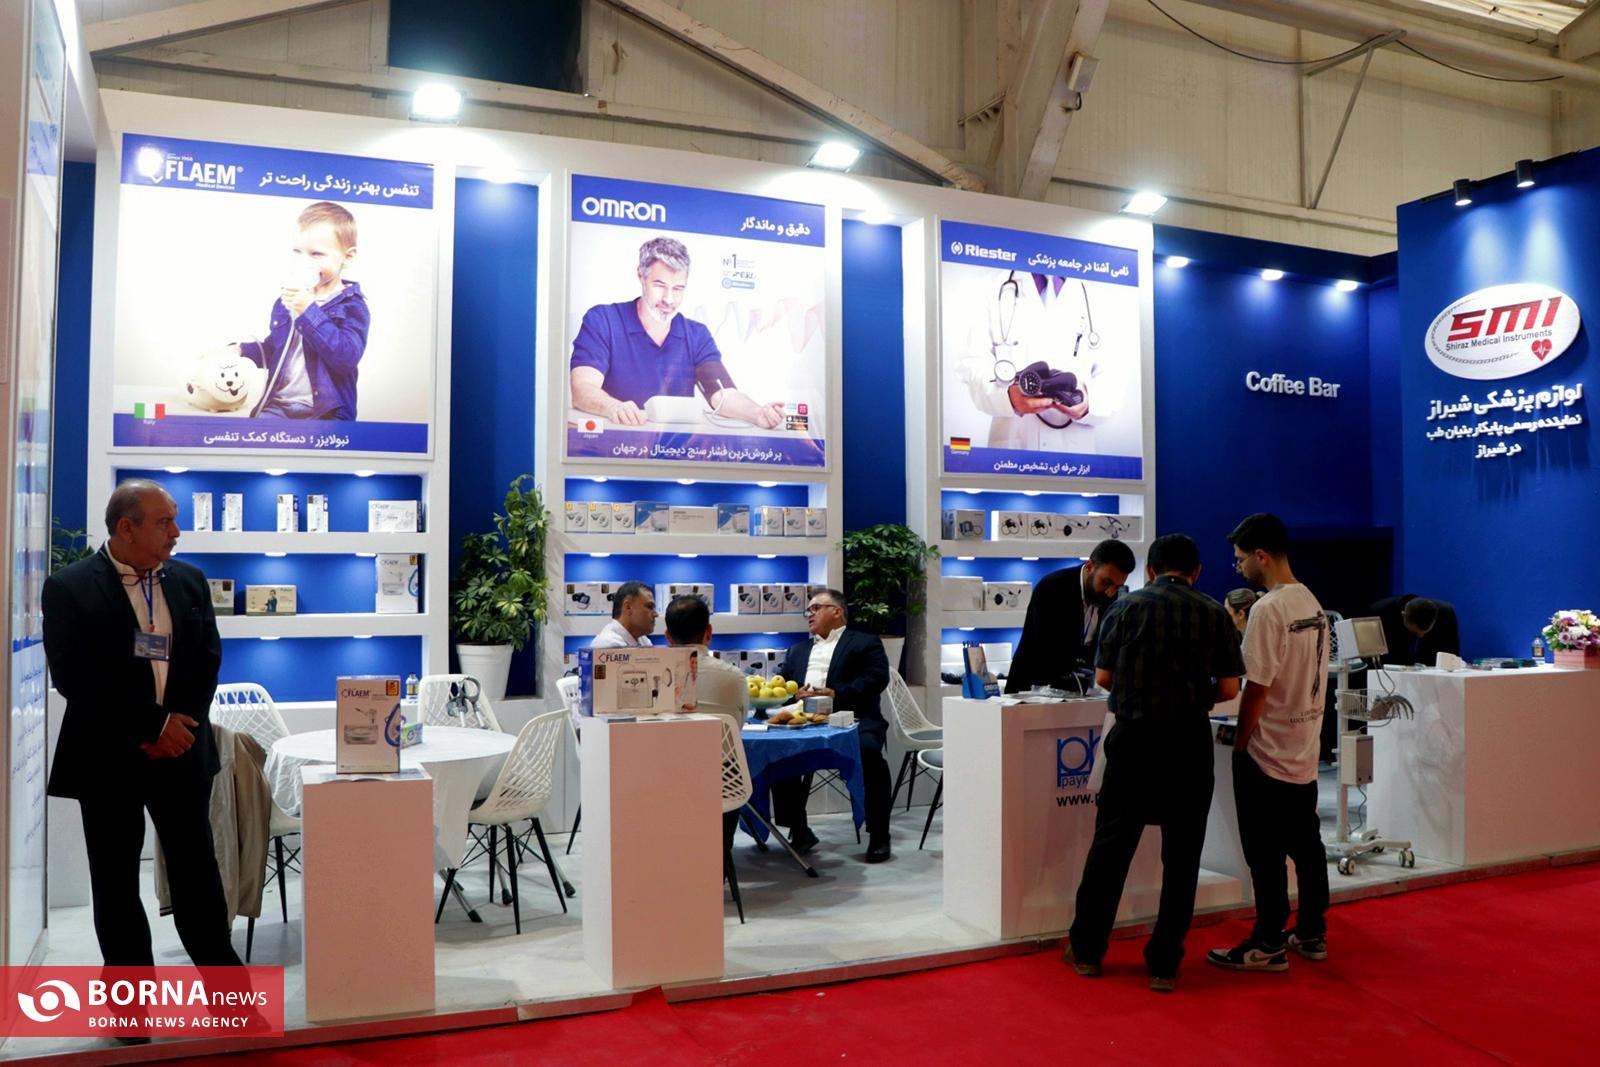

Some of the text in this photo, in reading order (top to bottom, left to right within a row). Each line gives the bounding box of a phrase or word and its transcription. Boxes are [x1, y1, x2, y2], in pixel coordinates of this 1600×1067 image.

[165, 159, 237, 185] FLAEM
[259, 172, 273, 187] تر
[275, 173, 311, 191] راحت
[313, 174, 351, 194] زندگی
[383, 185, 420, 198] تنفس
[581, 196, 667, 223] OMRON
[740, 216, 811, 237] دقیق و ماندگار
[965, 243, 1017, 262] Riester
[1028, 253, 1129, 277] نامی آشنا در جامعه پزشکی
[1447, 296, 1563, 342] SMI
[1445, 329, 1553, 352] Shiraz Medical Instruments
[1246, 370, 1341, 398] Coffee Bar
[1426, 383, 1583, 420] لوازم پزشکی شیراز
[1426, 414, 1583, 440] نماینده رسمی پایکار بنیان طب
[203, 431, 240, 445] تنفسی
[242, 431, 268, 443] کمک
[270, 432, 306, 444] دستگاه
[315, 434, 349, 447] نبولایزر
[612, 443, 637, 455] جهان
[638, 447, 648, 456] در
[650, 444, 686, 456] دیجیتال
[687, 446, 707, 458] سنج
[707, 446, 728, 459] فشار
[1475, 441, 1522, 458] در شیراز
[993, 460, 1018, 471] مطمئن
[1018, 462, 1048, 472] تشخیص
[1061, 463, 1077, 475] حرفه
[1077, 464, 1091, 475] ابزار
[606, 653, 630, 662] FLAEM
